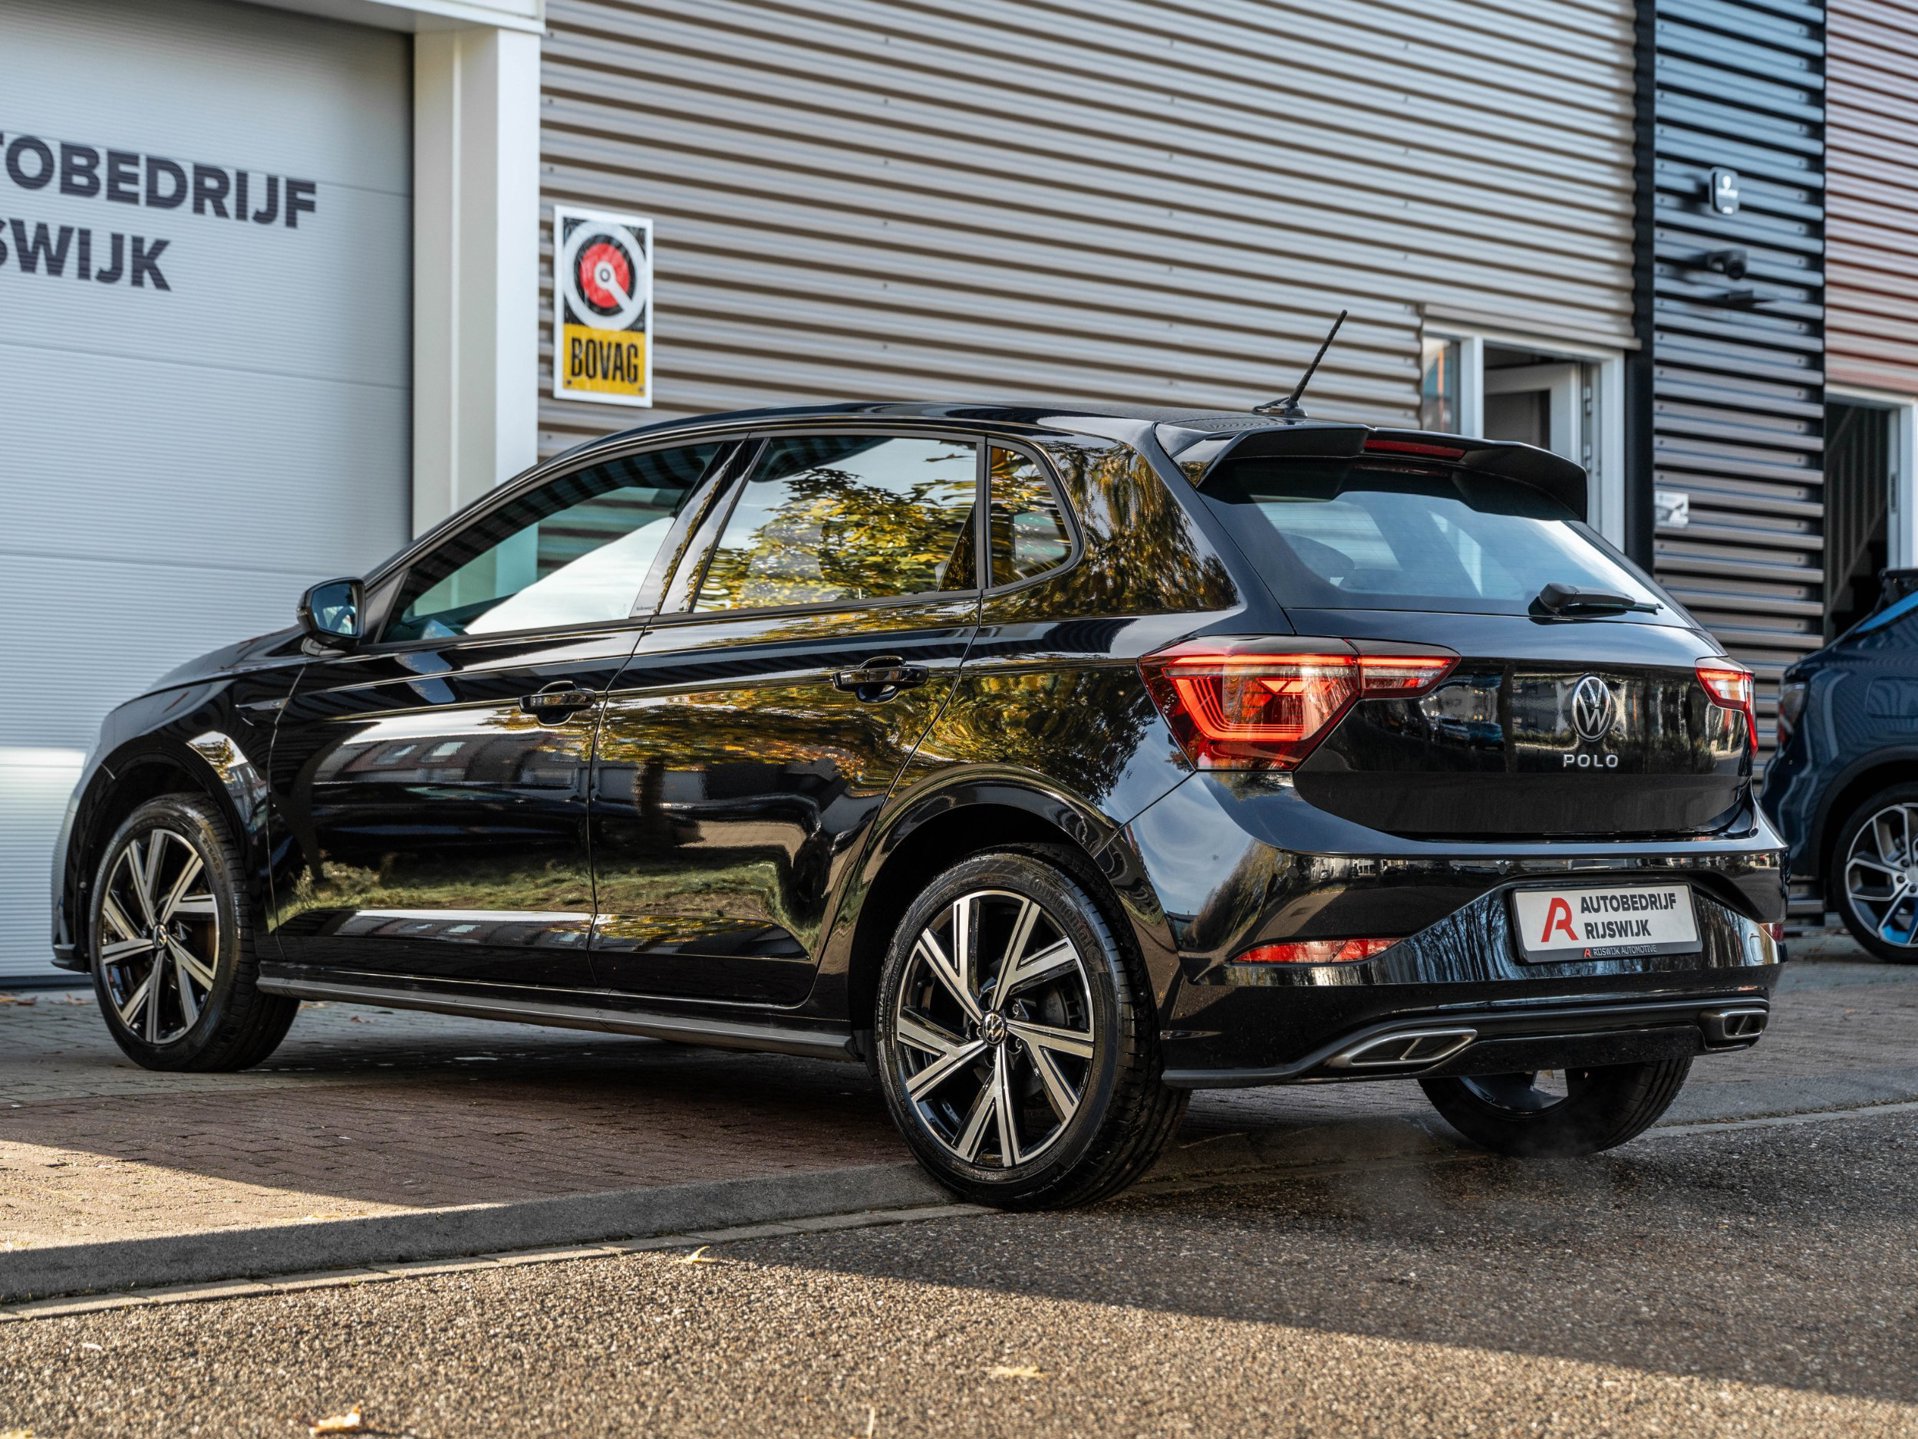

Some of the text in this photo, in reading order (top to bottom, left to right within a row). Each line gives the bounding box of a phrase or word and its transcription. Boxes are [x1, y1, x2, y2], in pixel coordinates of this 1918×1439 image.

[0, 132, 316, 229] OBEDRIJF
[0, 218, 171, 292] WIJK
[571, 337, 639, 384] BOVAG
[1563, 754, 1619, 768] POLO
[1580, 892, 1677, 914] AUTOBEDRIJF
[1584, 919, 1652, 940] RIJSWIJK
[1592, 947, 1621, 957] RIJSWIJK
[1621, 944, 1658, 955] AUTOMOTIVE
